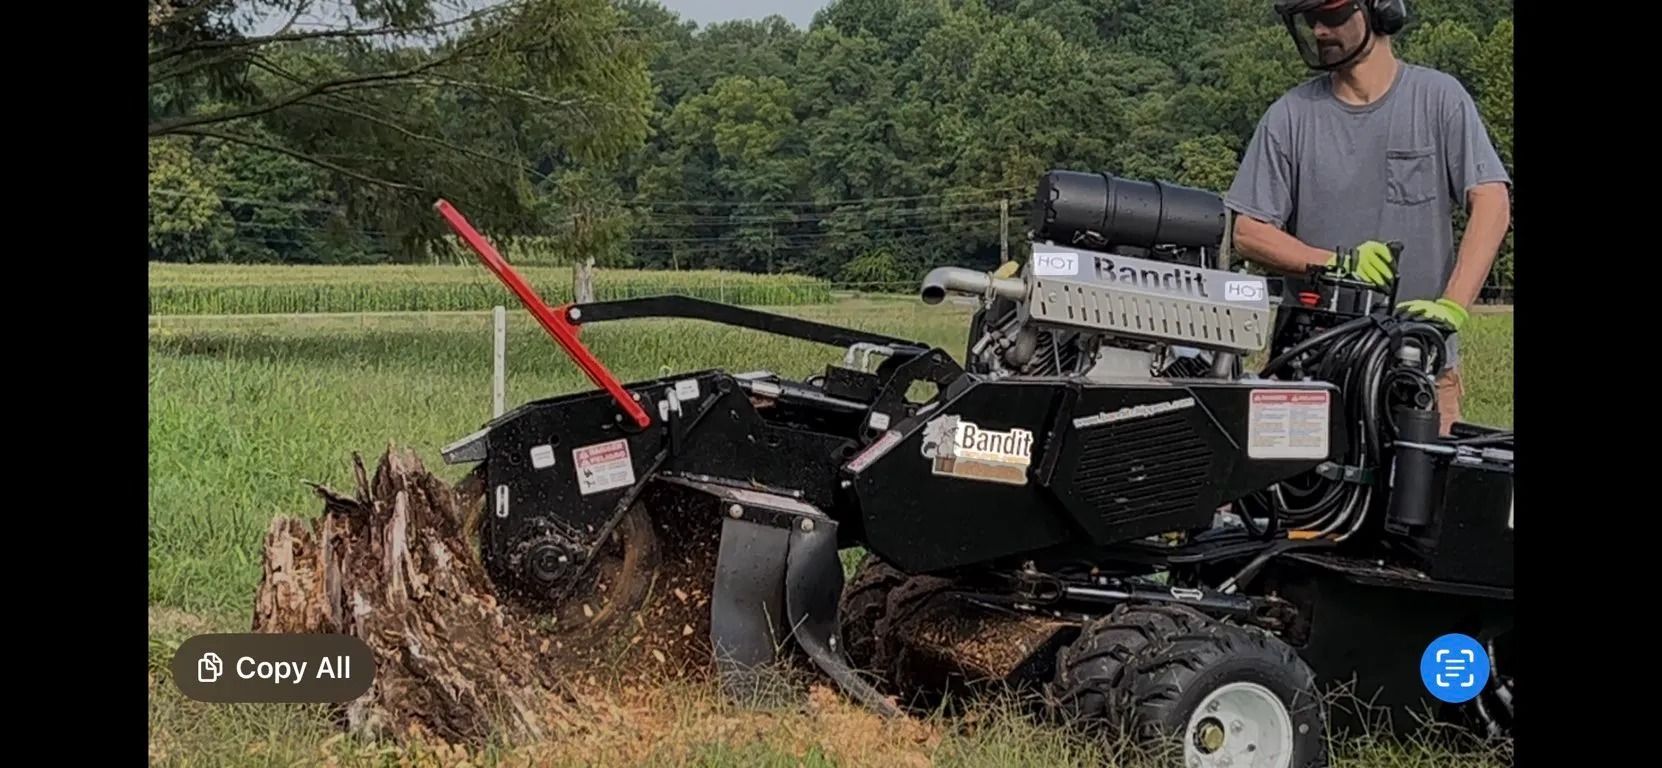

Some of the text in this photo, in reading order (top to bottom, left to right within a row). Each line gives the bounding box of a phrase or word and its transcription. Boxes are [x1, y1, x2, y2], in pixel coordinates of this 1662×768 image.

[1038, 255, 1073, 270] HOT
[1094, 256, 1209, 298] Bandit
[1228, 283, 1264, 298] HOT
[962, 425, 1032, 457] Bandit
